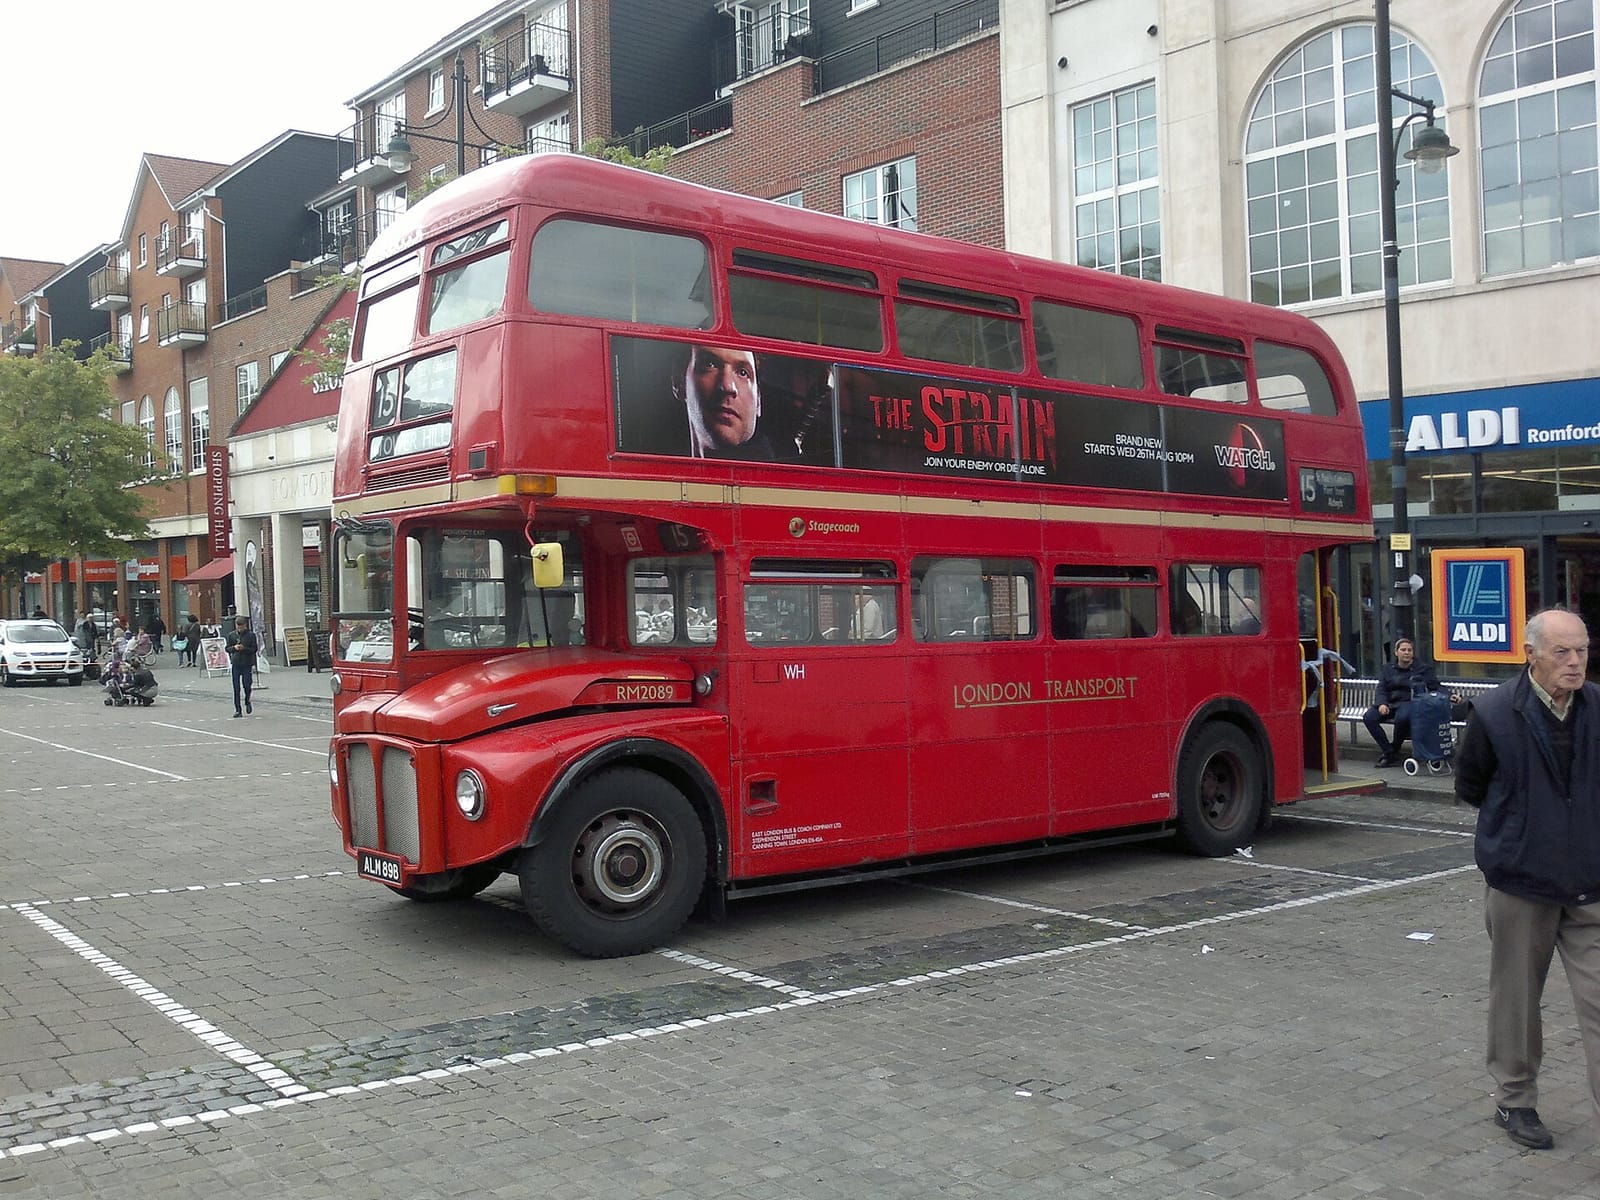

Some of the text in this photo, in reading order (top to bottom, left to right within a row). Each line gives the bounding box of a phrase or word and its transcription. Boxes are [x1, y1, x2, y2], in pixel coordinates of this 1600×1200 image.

[377, 374, 397, 419] 15
[869, 385, 1057, 466] THE STRAIN
[1404, 407, 1520, 452] ALDI
[1527, 423, 1600, 443] Romford
[1115, 434, 1163, 449] BRAND NEW
[1084, 442, 1194, 463] STARTS WED 26TH AUG 10PM
[923, 456, 943, 467] JOIN
[944, 458, 966, 469] YOUR
[967, 460, 994, 471] ENEMY
[994, 462, 1006, 472] OR
[1006, 463, 1019, 473] DIE
[1301, 474, 1316, 502] 15
[211, 450, 225, 552] SHOPPING HALL
[671, 524, 689, 547] 15
[808, 520, 860, 535] Stagecoach
[1452, 622, 1507, 643] ALDI
[783, 664, 805, 679] WH
[616, 685, 674, 700] RM2089
[953, 677, 1138, 709] LONDON TRANSPORT
[763, 829, 783, 837] LONDON
[363, 855, 400, 880] ALM 89B
